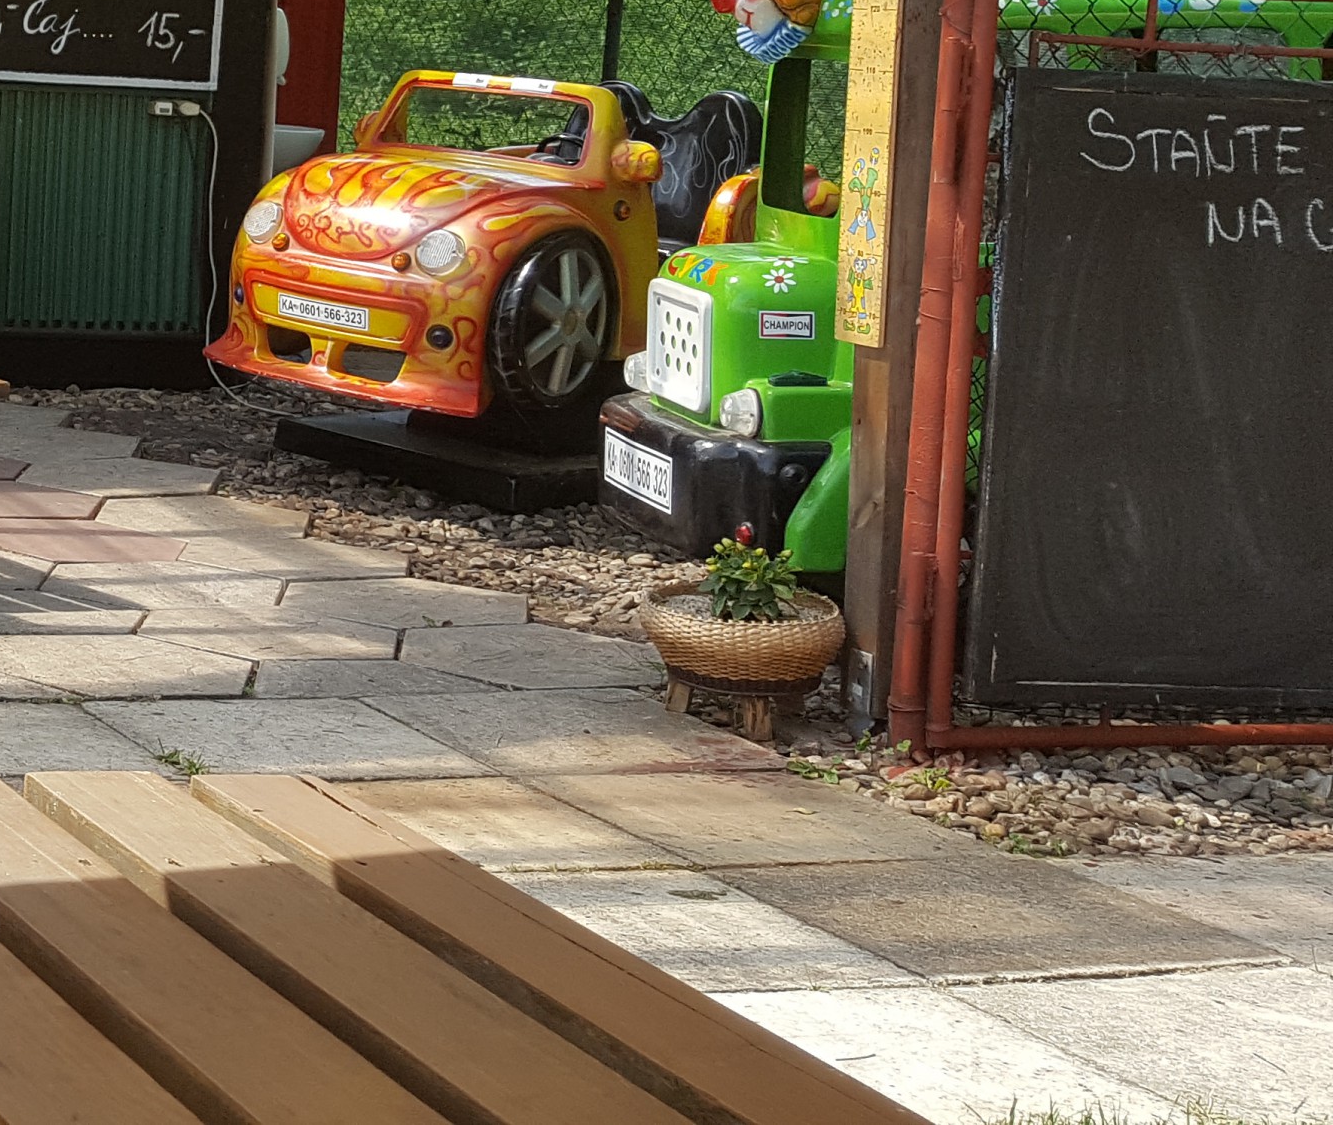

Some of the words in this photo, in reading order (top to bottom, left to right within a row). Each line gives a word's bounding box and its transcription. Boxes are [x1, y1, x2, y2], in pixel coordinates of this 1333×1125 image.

[1206, 197, 1283, 247] NA
[668, 252, 729, 286] CYRK
[763, 318, 811, 332] CHAMPION
